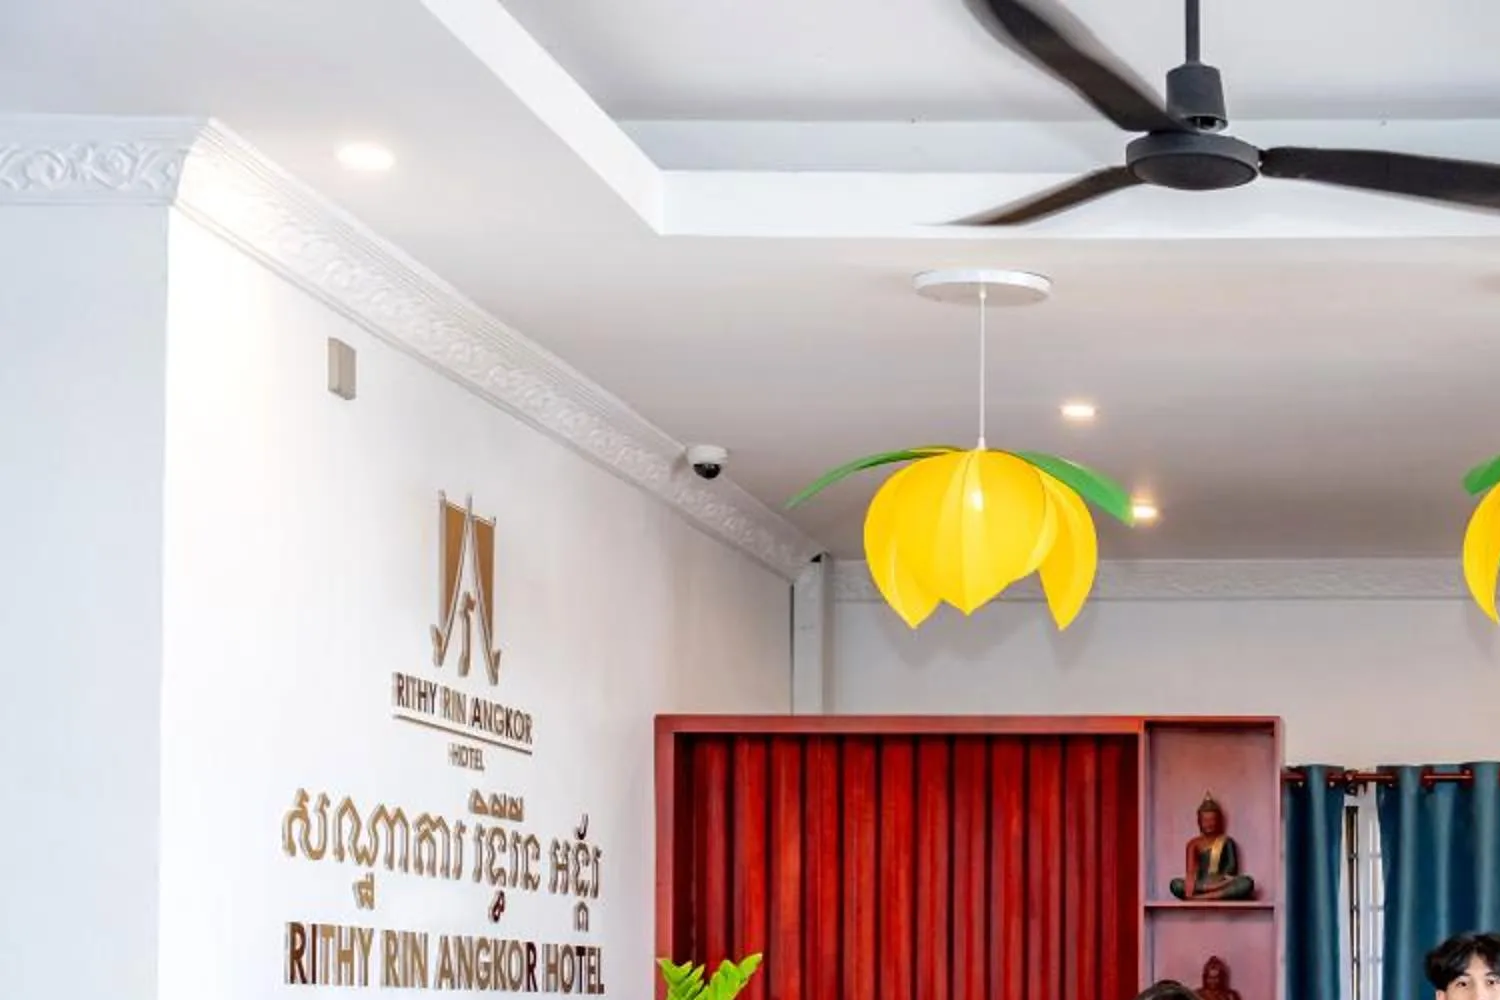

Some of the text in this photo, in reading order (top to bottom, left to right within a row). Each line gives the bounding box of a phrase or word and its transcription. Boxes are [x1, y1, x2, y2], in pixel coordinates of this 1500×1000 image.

[393, 672, 533, 745] RITHY RIN ANGKOR
[448, 743, 484, 771] HOTEL
[285, 921, 605, 995] RITHY RIN ANGKOR HOTEL
